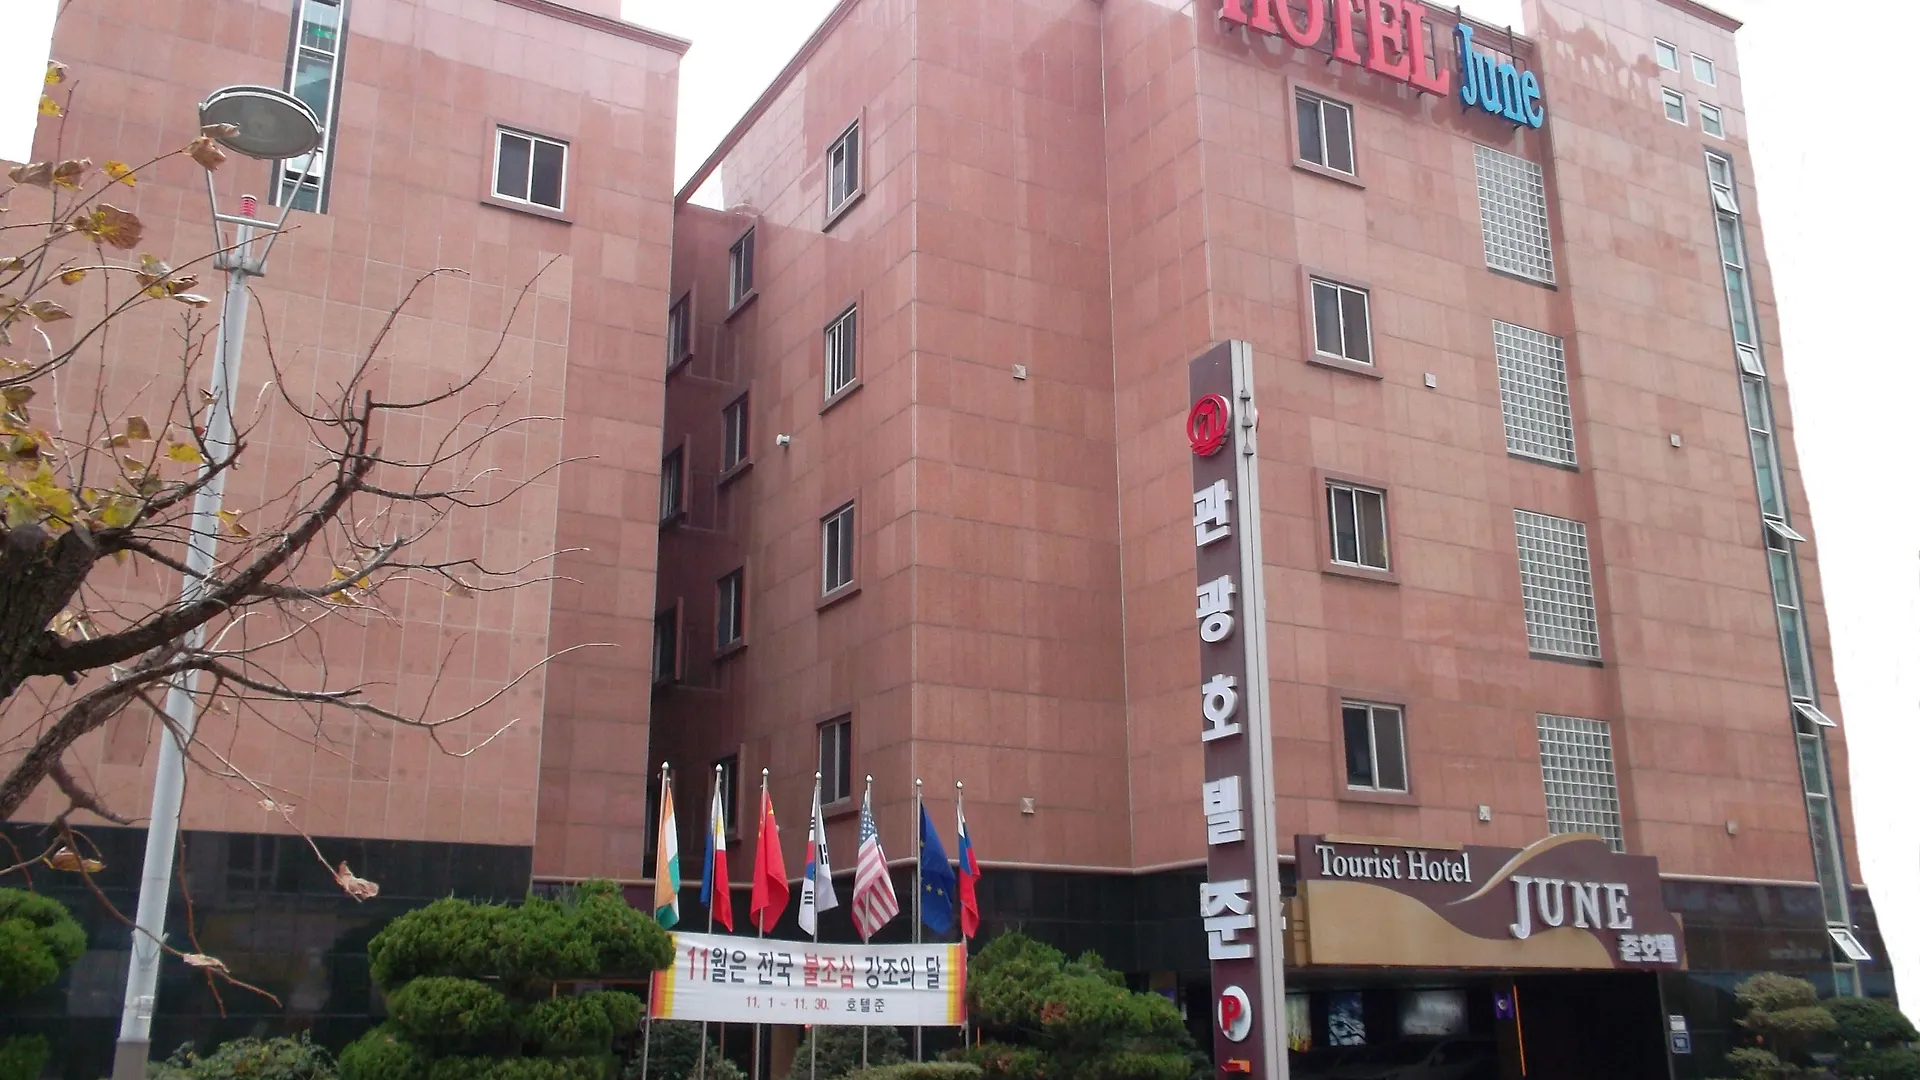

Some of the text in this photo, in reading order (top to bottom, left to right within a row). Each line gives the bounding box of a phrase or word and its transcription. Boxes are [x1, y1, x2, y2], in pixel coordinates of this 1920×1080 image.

[1454, 22, 1544, 129] June
[1314, 844, 1472, 884] Tourist Hotel
[1509, 875, 1634, 940] JUNE
[687, 946, 941, 990] 11월은 전국 불조심 강조의 달
[1616, 933, 1678, 963] 준호텔
[1220, 994, 1242, 1032] P
